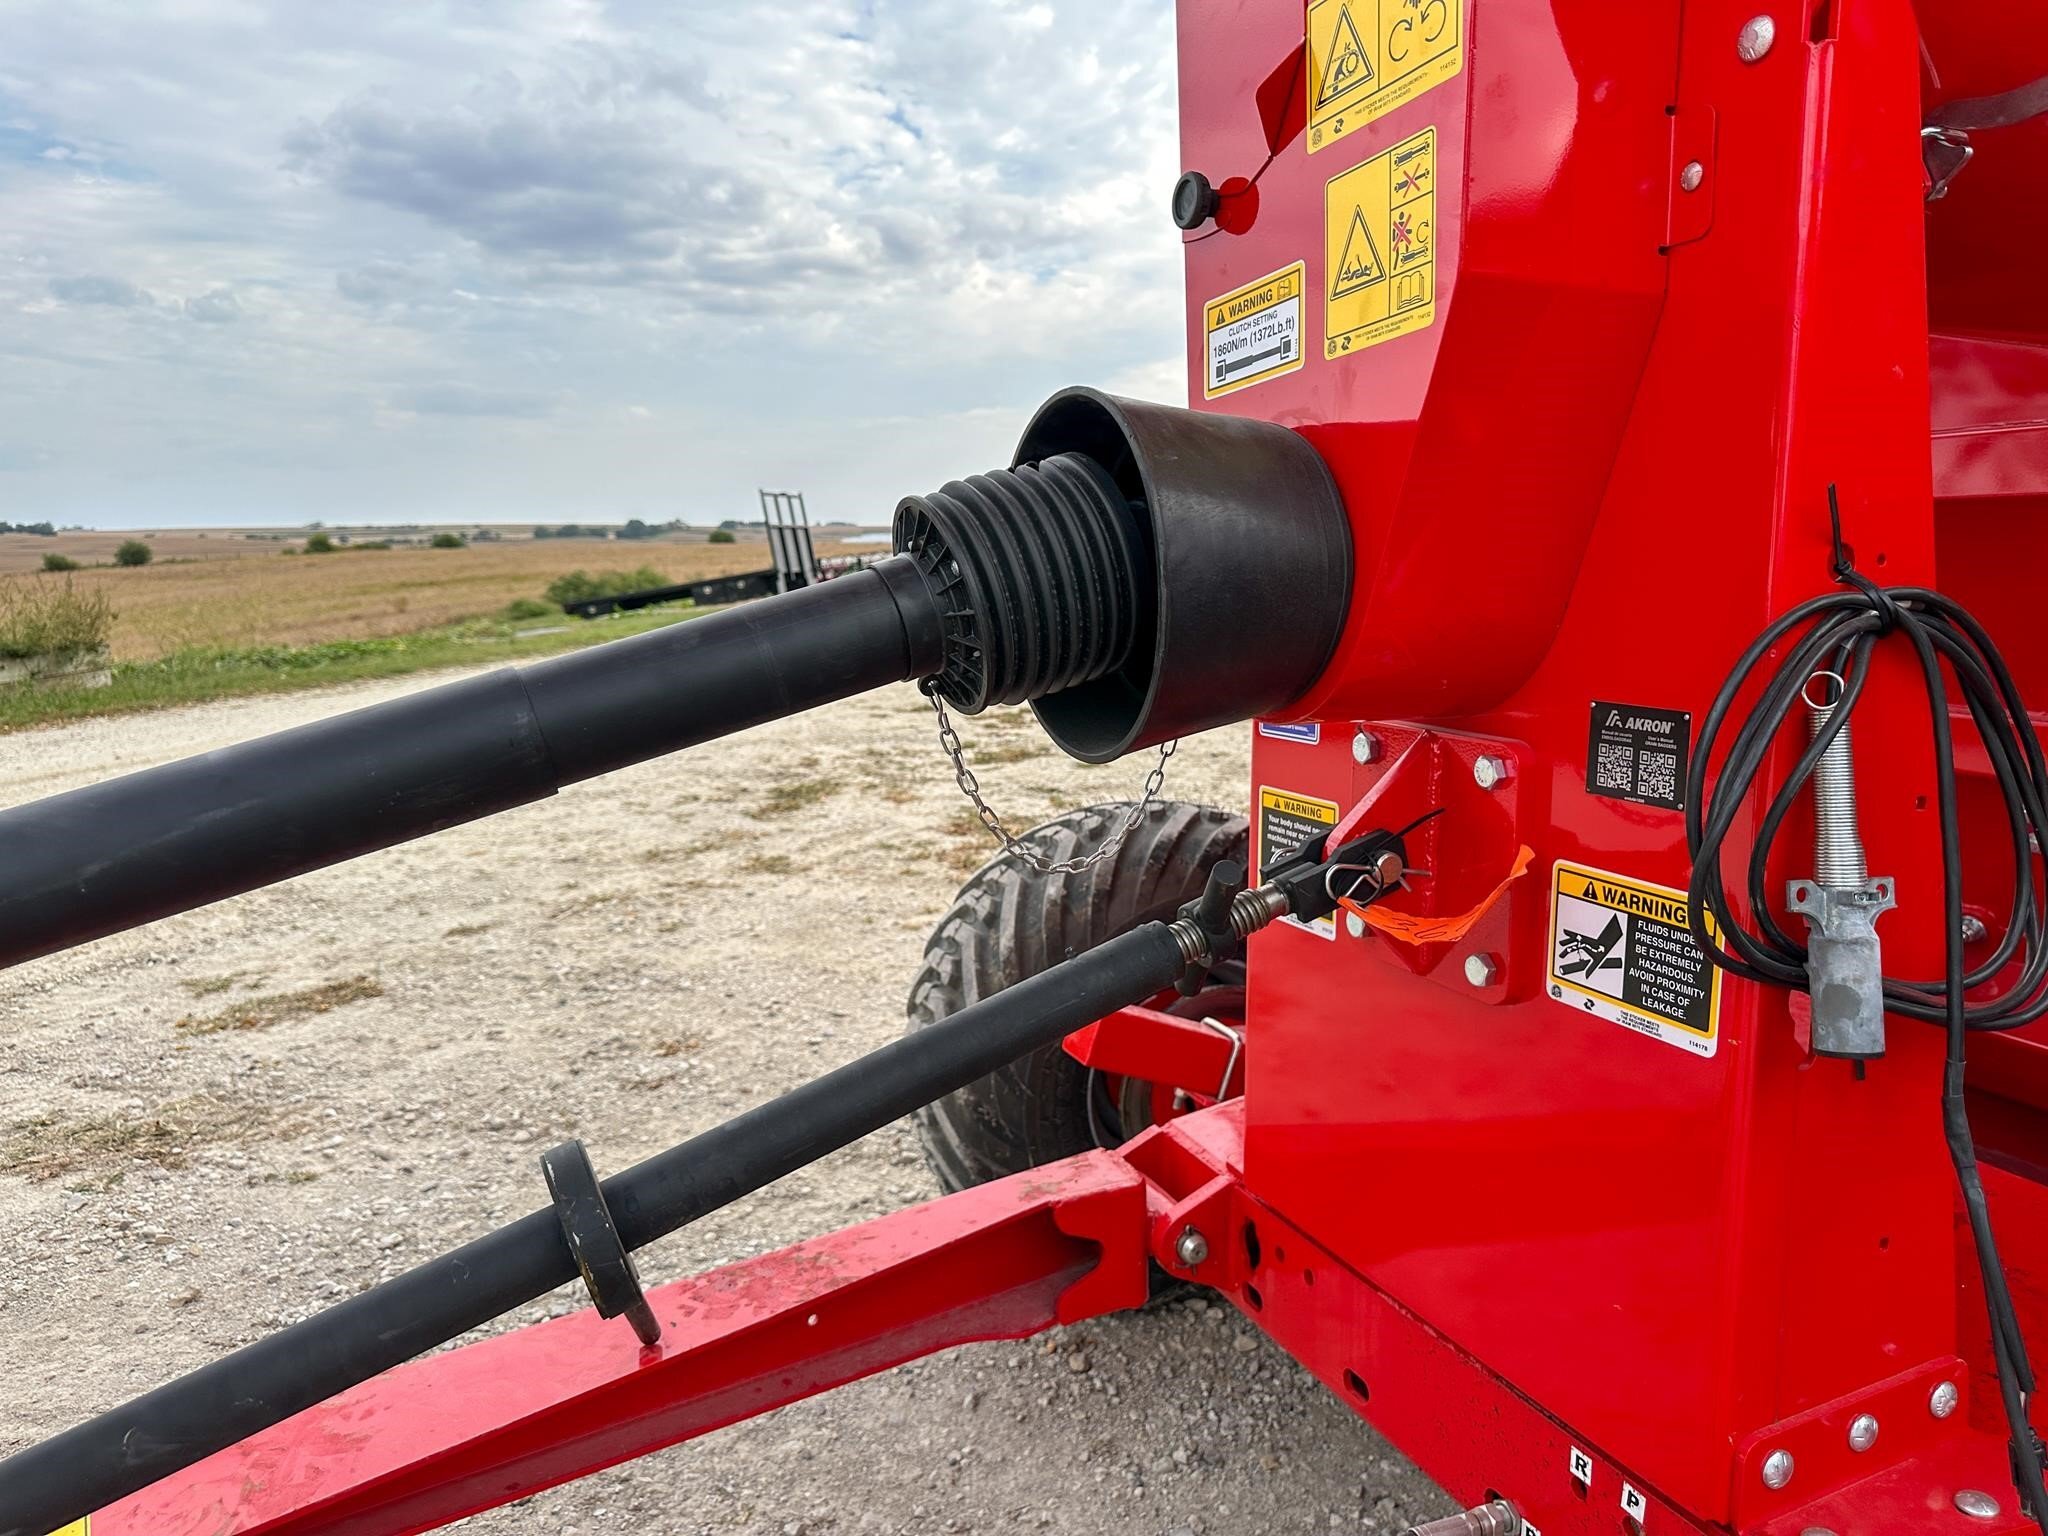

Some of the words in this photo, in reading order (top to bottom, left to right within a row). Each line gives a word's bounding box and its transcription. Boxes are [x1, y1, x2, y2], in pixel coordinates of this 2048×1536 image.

[1228, 288, 1273, 318] WARNING
[1228, 321, 1252, 337] CLUTCH
[1252, 310, 1278, 327] SETTING
[1213, 336, 1248, 358] 1860N/m
[1249, 315, 1295, 347] (1372Lb.ft)
[1625, 717, 1672, 734] AKRON
[1283, 799, 1322, 819] WARNING
[1268, 814, 1280, 824] Your
[1280, 817, 1293, 829] body
[1293, 822, 1312, 833] should
[1268, 824, 1286, 835] remain
[1286, 829, 1298, 838] near
[1267, 833, 1292, 846] machine's
[1602, 885, 1687, 925] WARNING
[1638, 920, 1669, 937] FLUIDS
[1670, 929, 1696, 945] UNDE
[1635, 931, 1682, 954] PRESSURE
[1683, 946, 1704, 961] CAN
[1635, 944, 1648, 956] BE
[1649, 948, 1702, 973] EXTREMELY
[1638, 957, 1696, 984] HAZARDOUS.
[1629, 967, 1655, 983] AVOID
[1656, 976, 1705, 999] PROXIMITY
[1640, 983, 1650, 994] IN
[1651, 987, 1676, 1003] CASE
[1677, 996, 1691, 1007] OF
[1642, 996, 1687, 1020] LEAKAGE.
[1628, 1017, 1659, 1032] REQUIREMENTS
[1629, 1013, 1646, 1023] STICKER
[1646, 1020, 1660, 1028] MEETS
[1575, 1453, 1588, 1478] R
[1626, 1489, 1640, 1508] P
